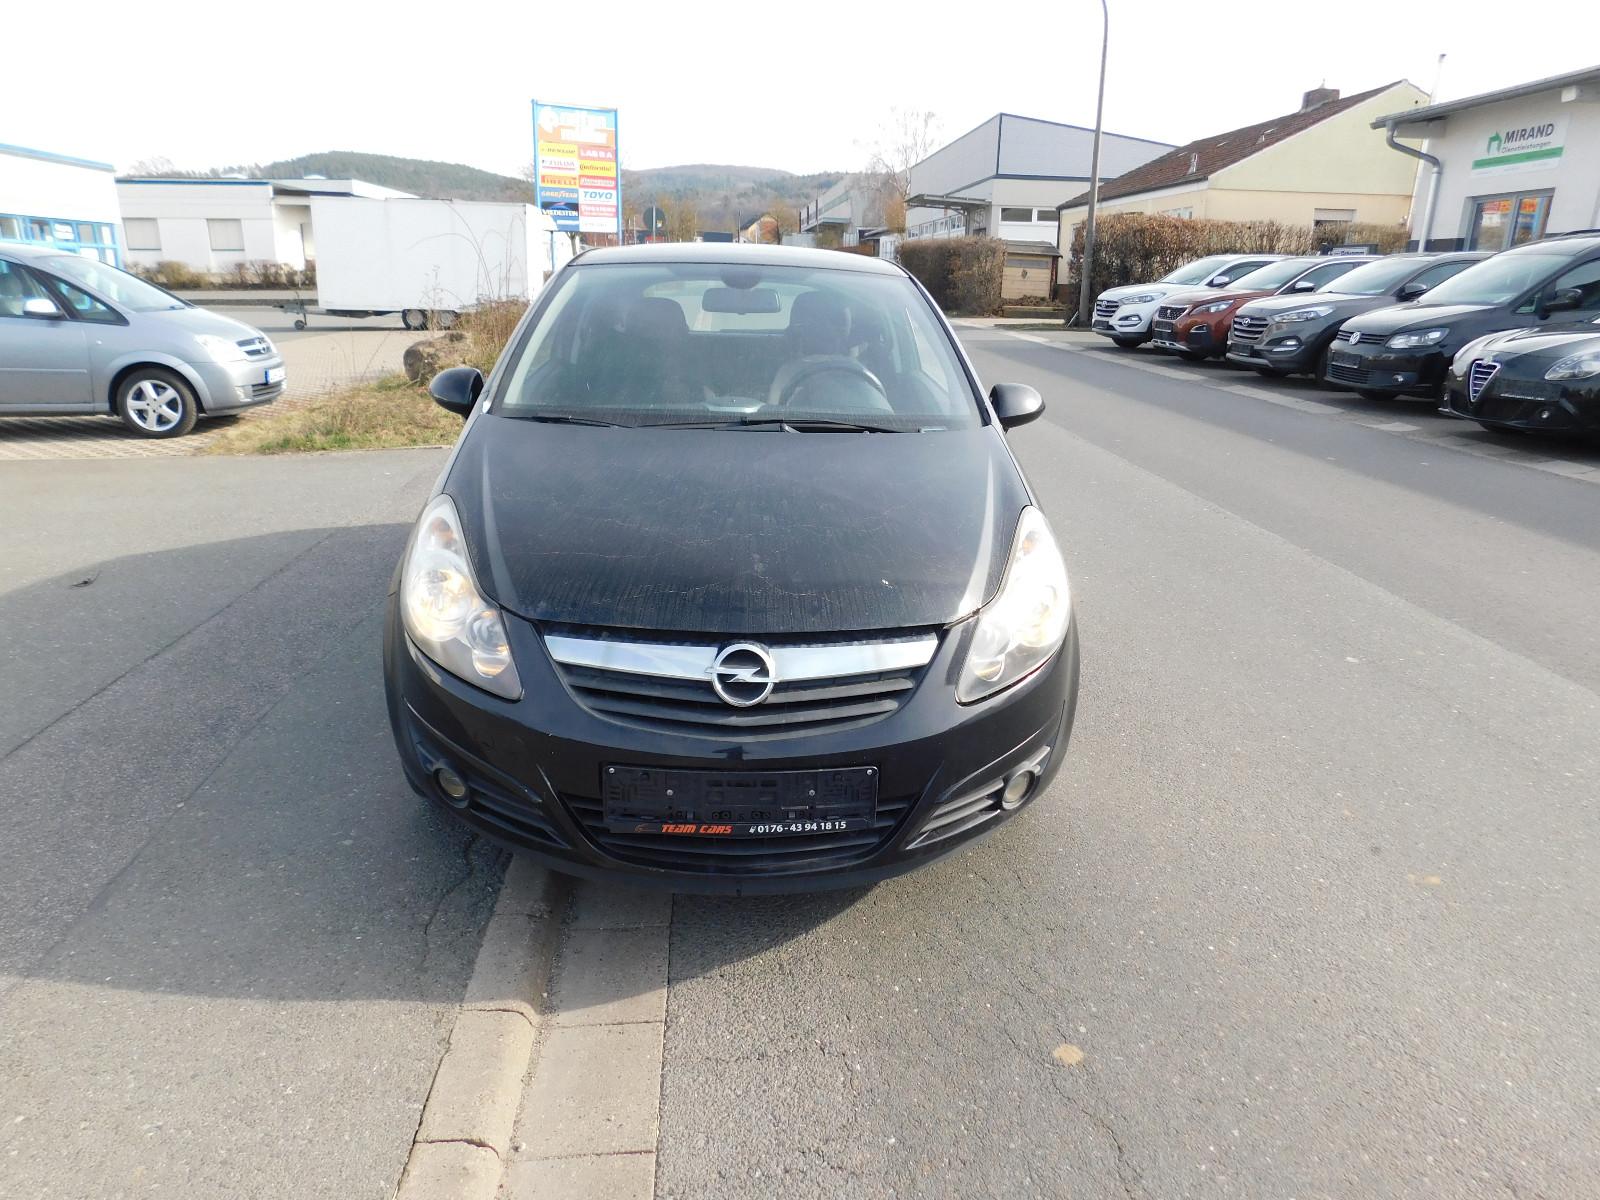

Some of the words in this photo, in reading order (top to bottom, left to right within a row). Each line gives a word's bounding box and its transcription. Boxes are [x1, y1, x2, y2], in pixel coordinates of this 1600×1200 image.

[1504, 123, 1555, 145] MIRAND
[1501, 141, 1552, 154] Dienstleistungen
[583, 191, 613, 200] TOYO
[804, 822, 818, 831] 94
[820, 821, 832, 830] 18
[834, 821, 847, 829] 15
